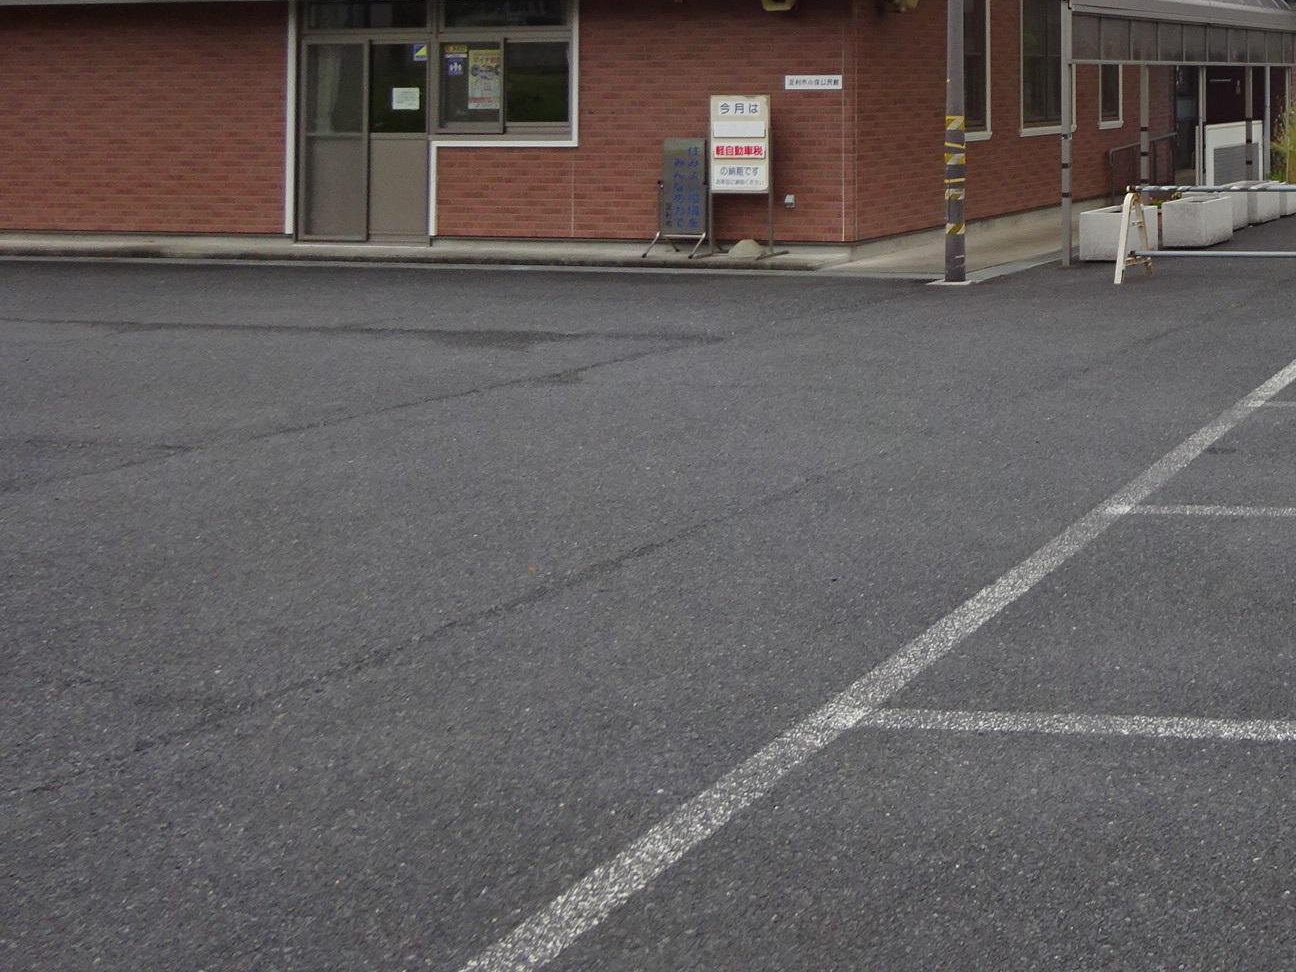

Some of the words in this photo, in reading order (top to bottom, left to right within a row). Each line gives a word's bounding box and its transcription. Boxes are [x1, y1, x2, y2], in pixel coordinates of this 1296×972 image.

[720, 102, 760, 115] 今月は
[715, 145, 763, 156] 軽自動車税
[720, 166, 759, 177] の納期です
